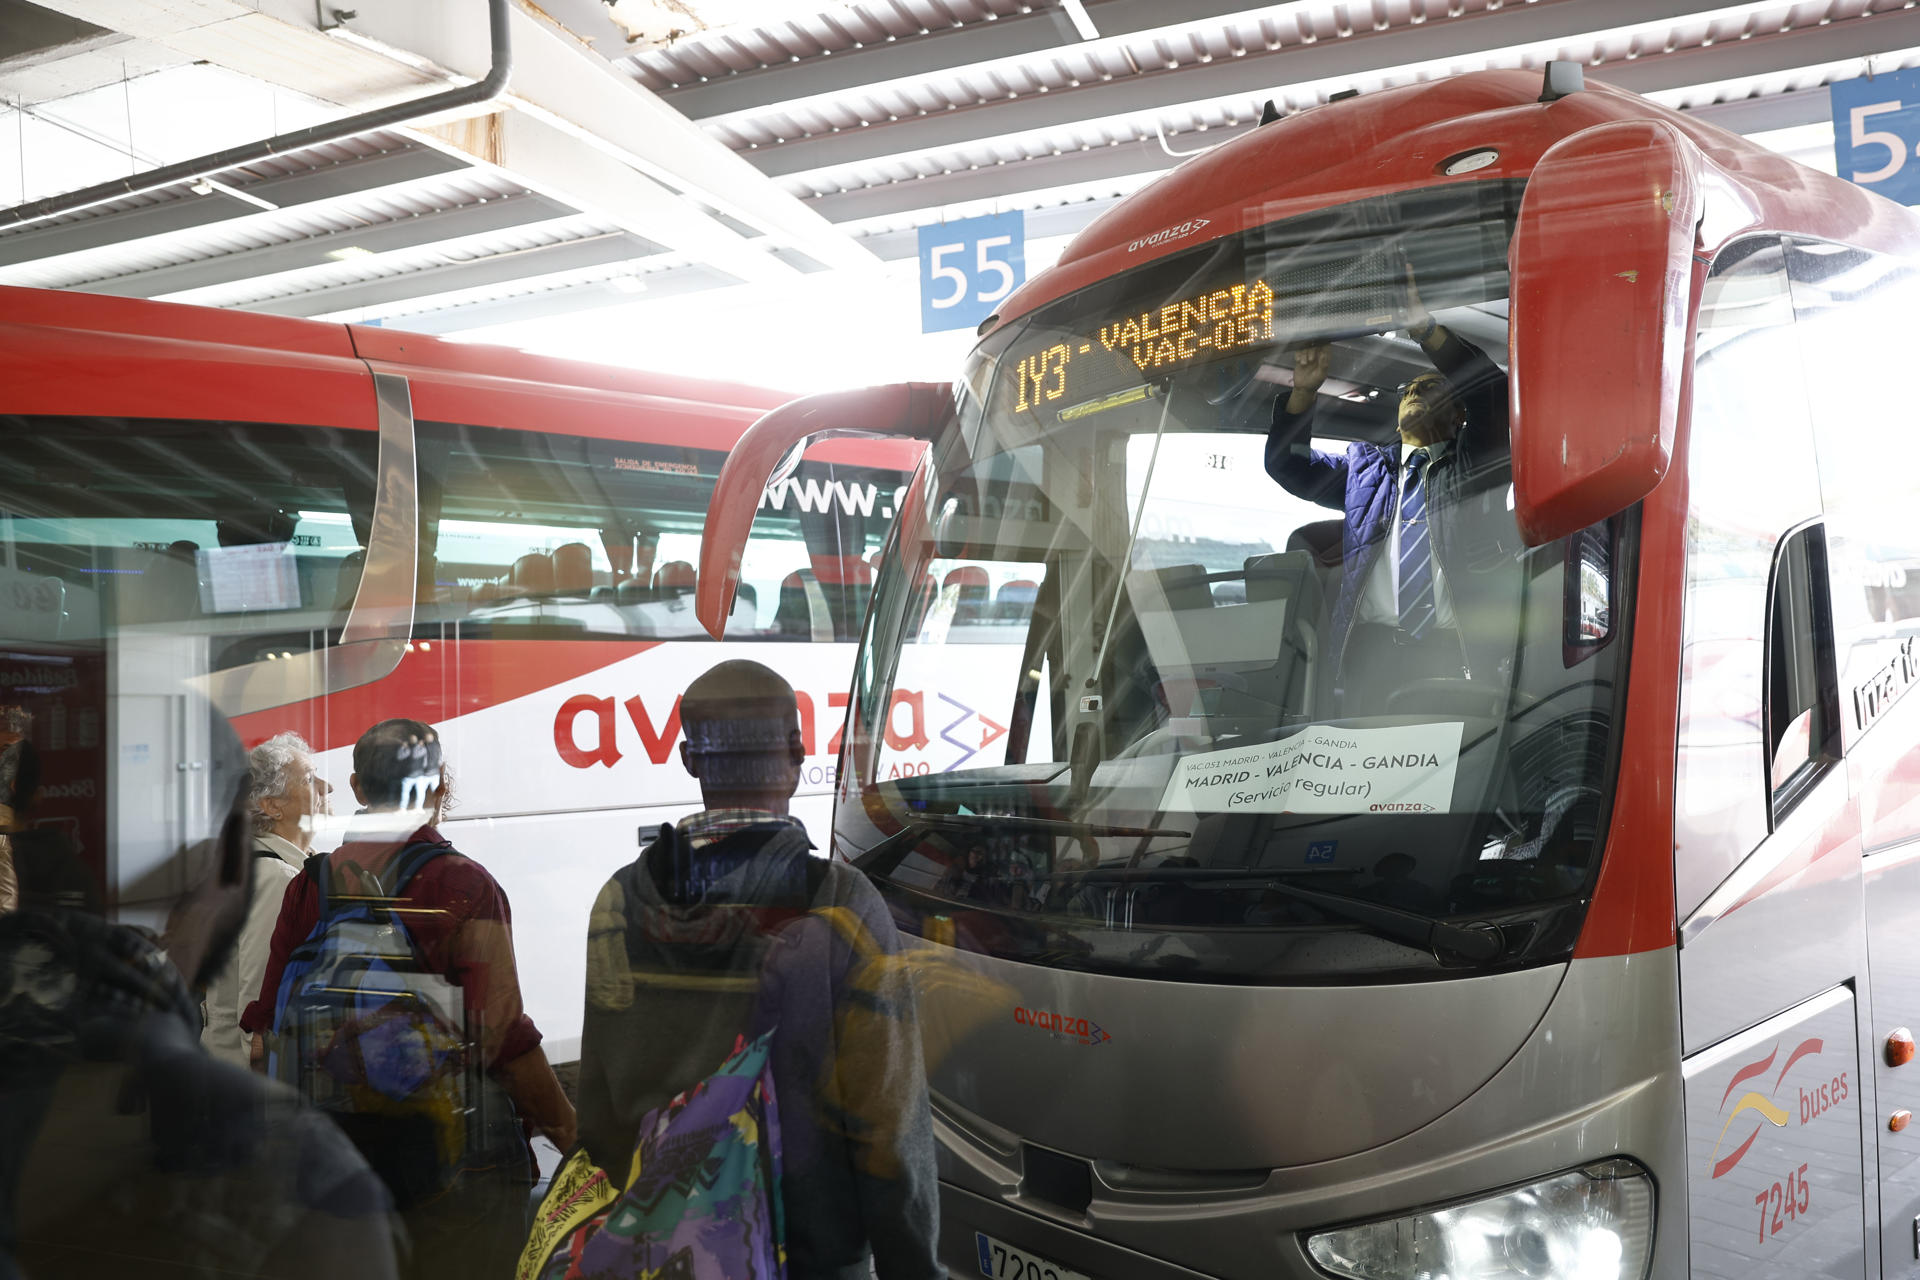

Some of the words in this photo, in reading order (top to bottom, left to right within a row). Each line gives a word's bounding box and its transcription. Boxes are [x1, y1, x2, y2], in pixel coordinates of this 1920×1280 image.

[1849, 100, 1920, 184] 5
[1127, 221, 1193, 252] avanza
[930, 234, 1015, 310] 55
[1100, 279, 1274, 352] VALENCIA
[1132, 309, 1275, 371] VAC-051
[1185, 771, 1250, 789] MADRID
[1266, 752, 1344, 778] VALENCIA
[1362, 753, 1439, 770] GANDIA
[1222, 755, 1260, 768] MADRID
[1268, 739, 1305, 759] VALENCIA
[1314, 736, 1358, 750] GANDIA
[1228, 781, 1292, 807] (Servicio
[1295, 778, 1372, 799] regular)
[1369, 802, 1422, 812] avanza
[1013, 1006, 1089, 1037] avanza
[1799, 1071, 1849, 1126] bus.es
[1755, 1162, 1810, 1245] 7245
